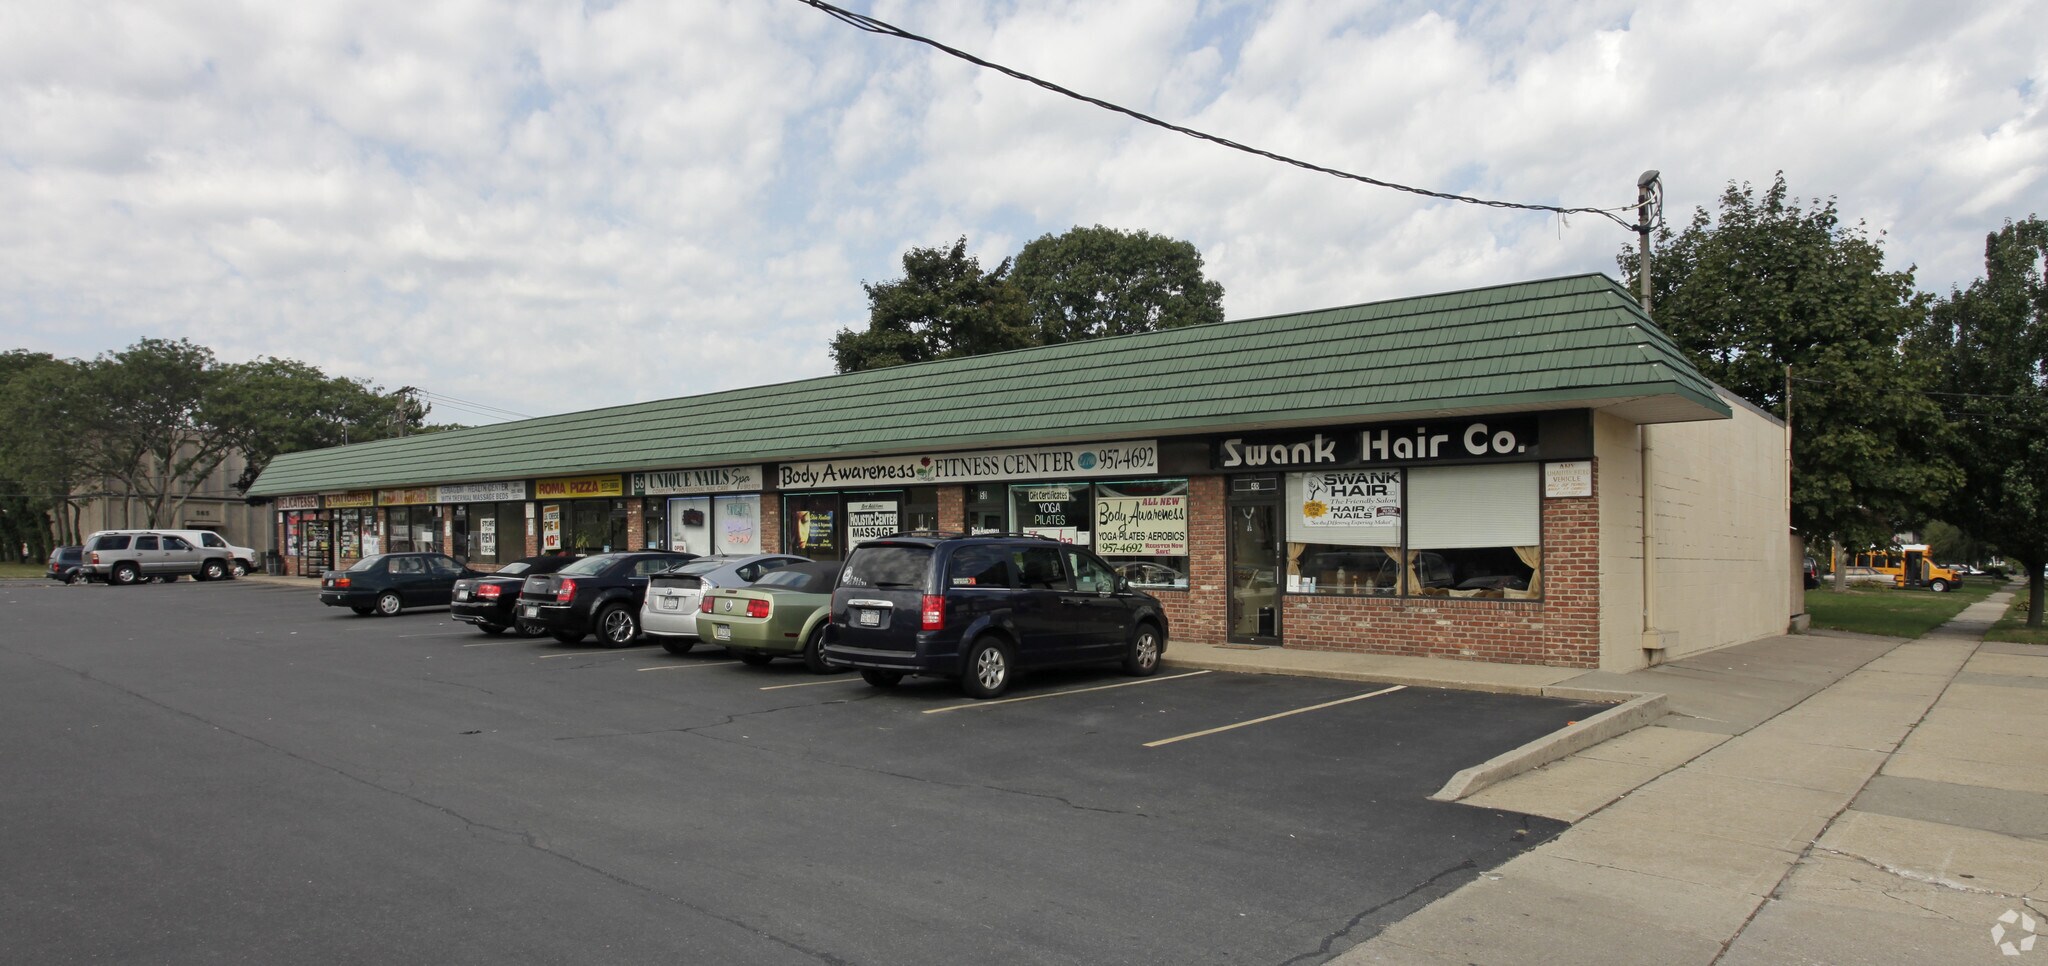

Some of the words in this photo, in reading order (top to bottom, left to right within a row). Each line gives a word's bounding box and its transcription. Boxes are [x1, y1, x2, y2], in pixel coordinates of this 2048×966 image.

[1224, 434, 1336, 467] Swank
[1363, 427, 1448, 461] Hair
[1464, 424, 1526, 455] Co.
[780, 465, 819, 487] Body
[822, 464, 916, 482] Awareness
[934, 456, 999, 478] FITNESS
[1003, 451, 1075, 474] CENTER
[1099, 447, 1154, 470] 957-4692
[634, 477, 644, 489] 56
[650, 472, 692, 491] UNIQUE
[694, 469, 730, 486] NAILS
[731, 468, 750, 489] Spa
[1324, 472, 1400, 486] SWANK
[488, 482, 509, 492] CENTER
[538, 482, 566, 494] ROMA
[570, 480, 598, 494] PIZZA
[1331, 484, 1387, 497] HAIR
[327, 493, 371, 506] STATIONERY
[496, 492, 508, 500] BEDS
[1038, 490, 1068, 500] Certificates
[278, 496, 318, 508] DELICATESSEN
[1038, 502, 1060, 513] YOGA
[1142, 498, 1158, 506] ALL
[1160, 497, 1180, 505] NEW
[850, 512, 874, 526] HOLISTIC
[874, 512, 898, 526] CENTER
[1034, 514, 1066, 526] PILATES
[1098, 502, 1127, 532] Body
[1128, 501, 1184, 527] Awareness
[544, 521, 554, 532] PIE
[852, 527, 894, 538] MASSAGE
[482, 532, 496, 544] RENT
[1098, 532, 1116, 540] YOGA
[1118, 532, 1146, 540] PILATES
[1148, 531, 1184, 540] AEROBICS
[1102, 542, 1142, 553] 957-4692
